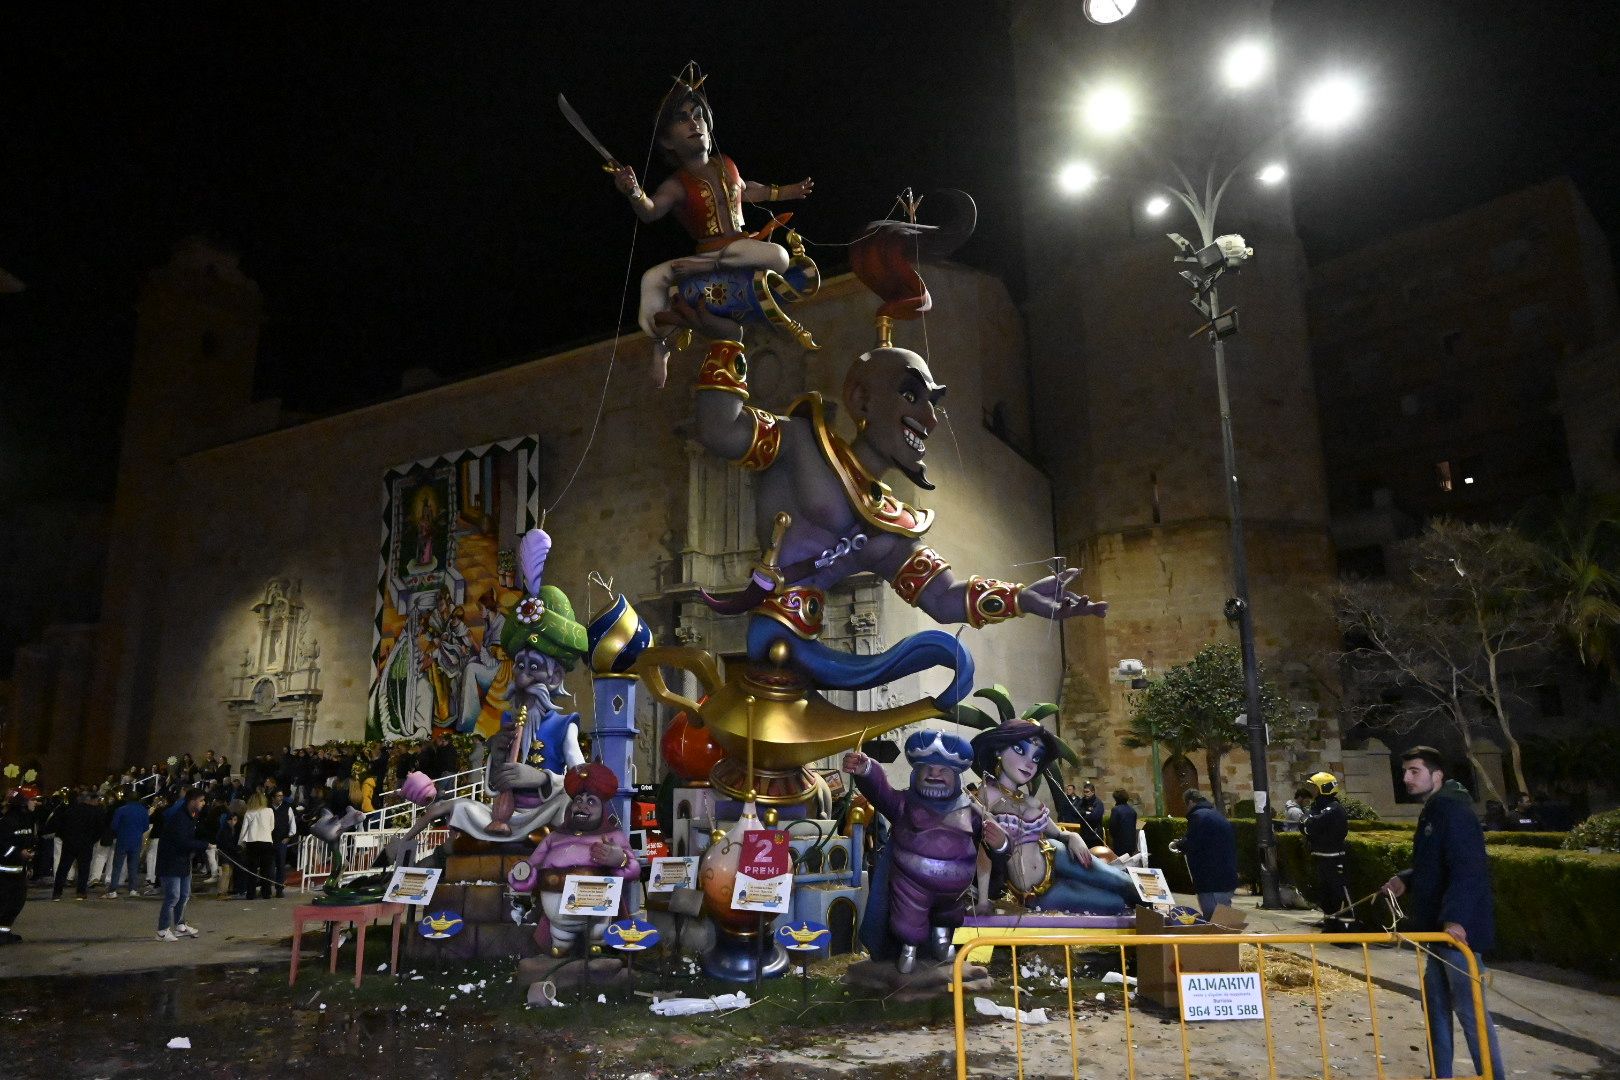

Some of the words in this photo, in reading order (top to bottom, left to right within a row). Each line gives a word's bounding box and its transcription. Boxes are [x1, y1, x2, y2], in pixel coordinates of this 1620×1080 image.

[753, 839, 773, 863] 2
[744, 866, 779, 875] PREMI
[1188, 977, 1255, 991] ALMAKIVI
[1188, 1006, 1210, 1017] 964
[1214, 1005, 1233, 1016] 591
[1237, 1004, 1258, 1015] 588
